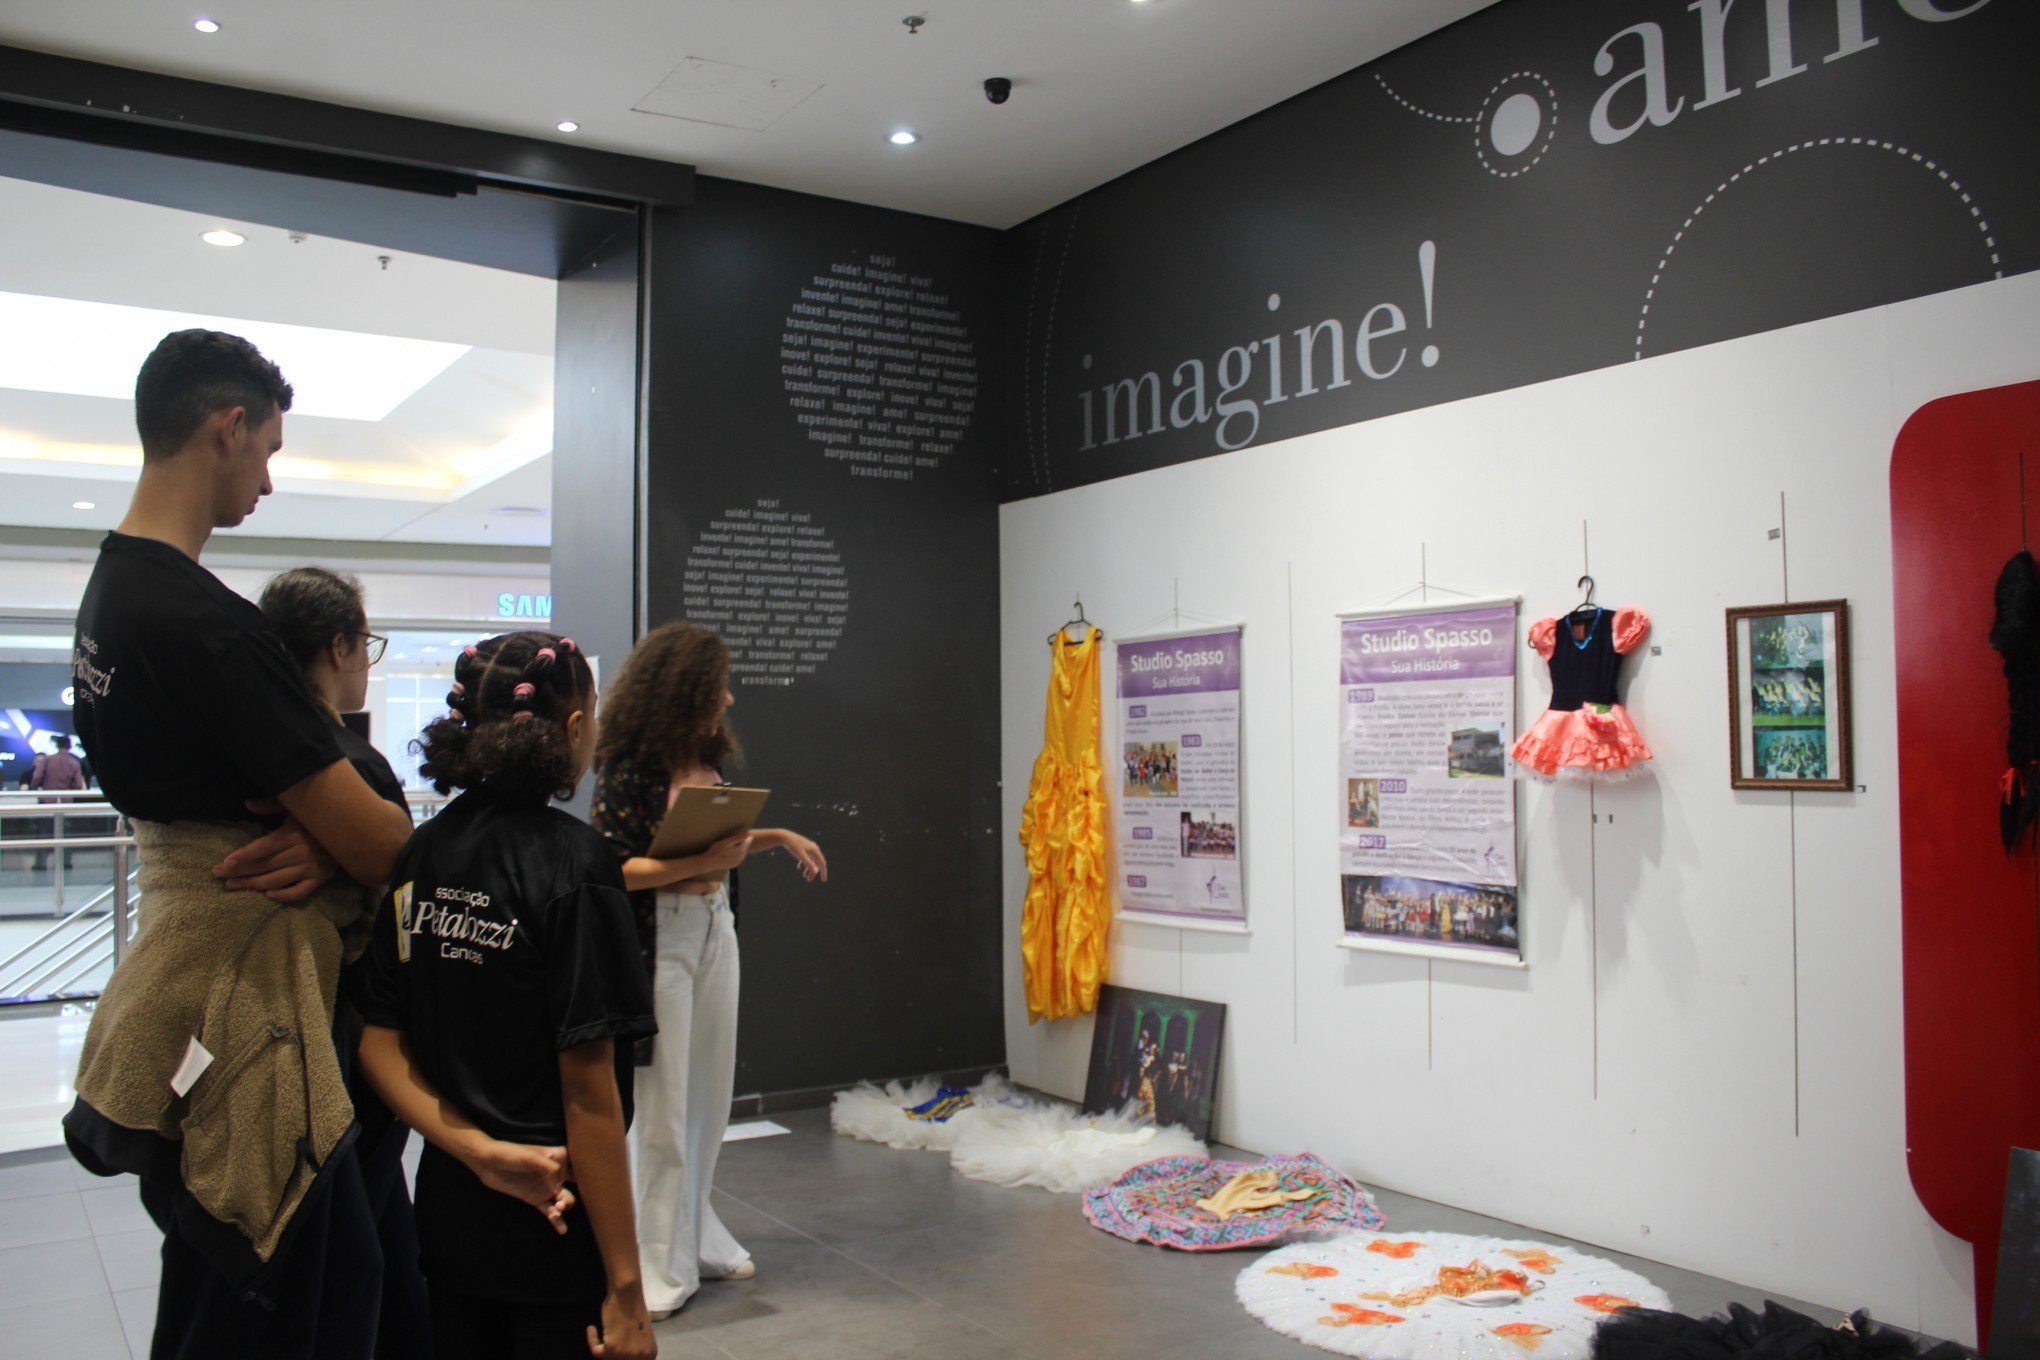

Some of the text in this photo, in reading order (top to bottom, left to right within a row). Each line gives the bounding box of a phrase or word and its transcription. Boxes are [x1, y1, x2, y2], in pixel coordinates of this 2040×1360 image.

[1079, 240, 1441, 451] imagine!
[1361, 628, 1492, 654] Studio Spasso
[1131, 650, 1224, 672] Studio Spasso
[1391, 658, 1460, 673] Sua História
[1152, 676, 1201, 689] Sua História
[1380, 780, 1406, 792] 2010
[1360, 835, 1386, 848] 2017
